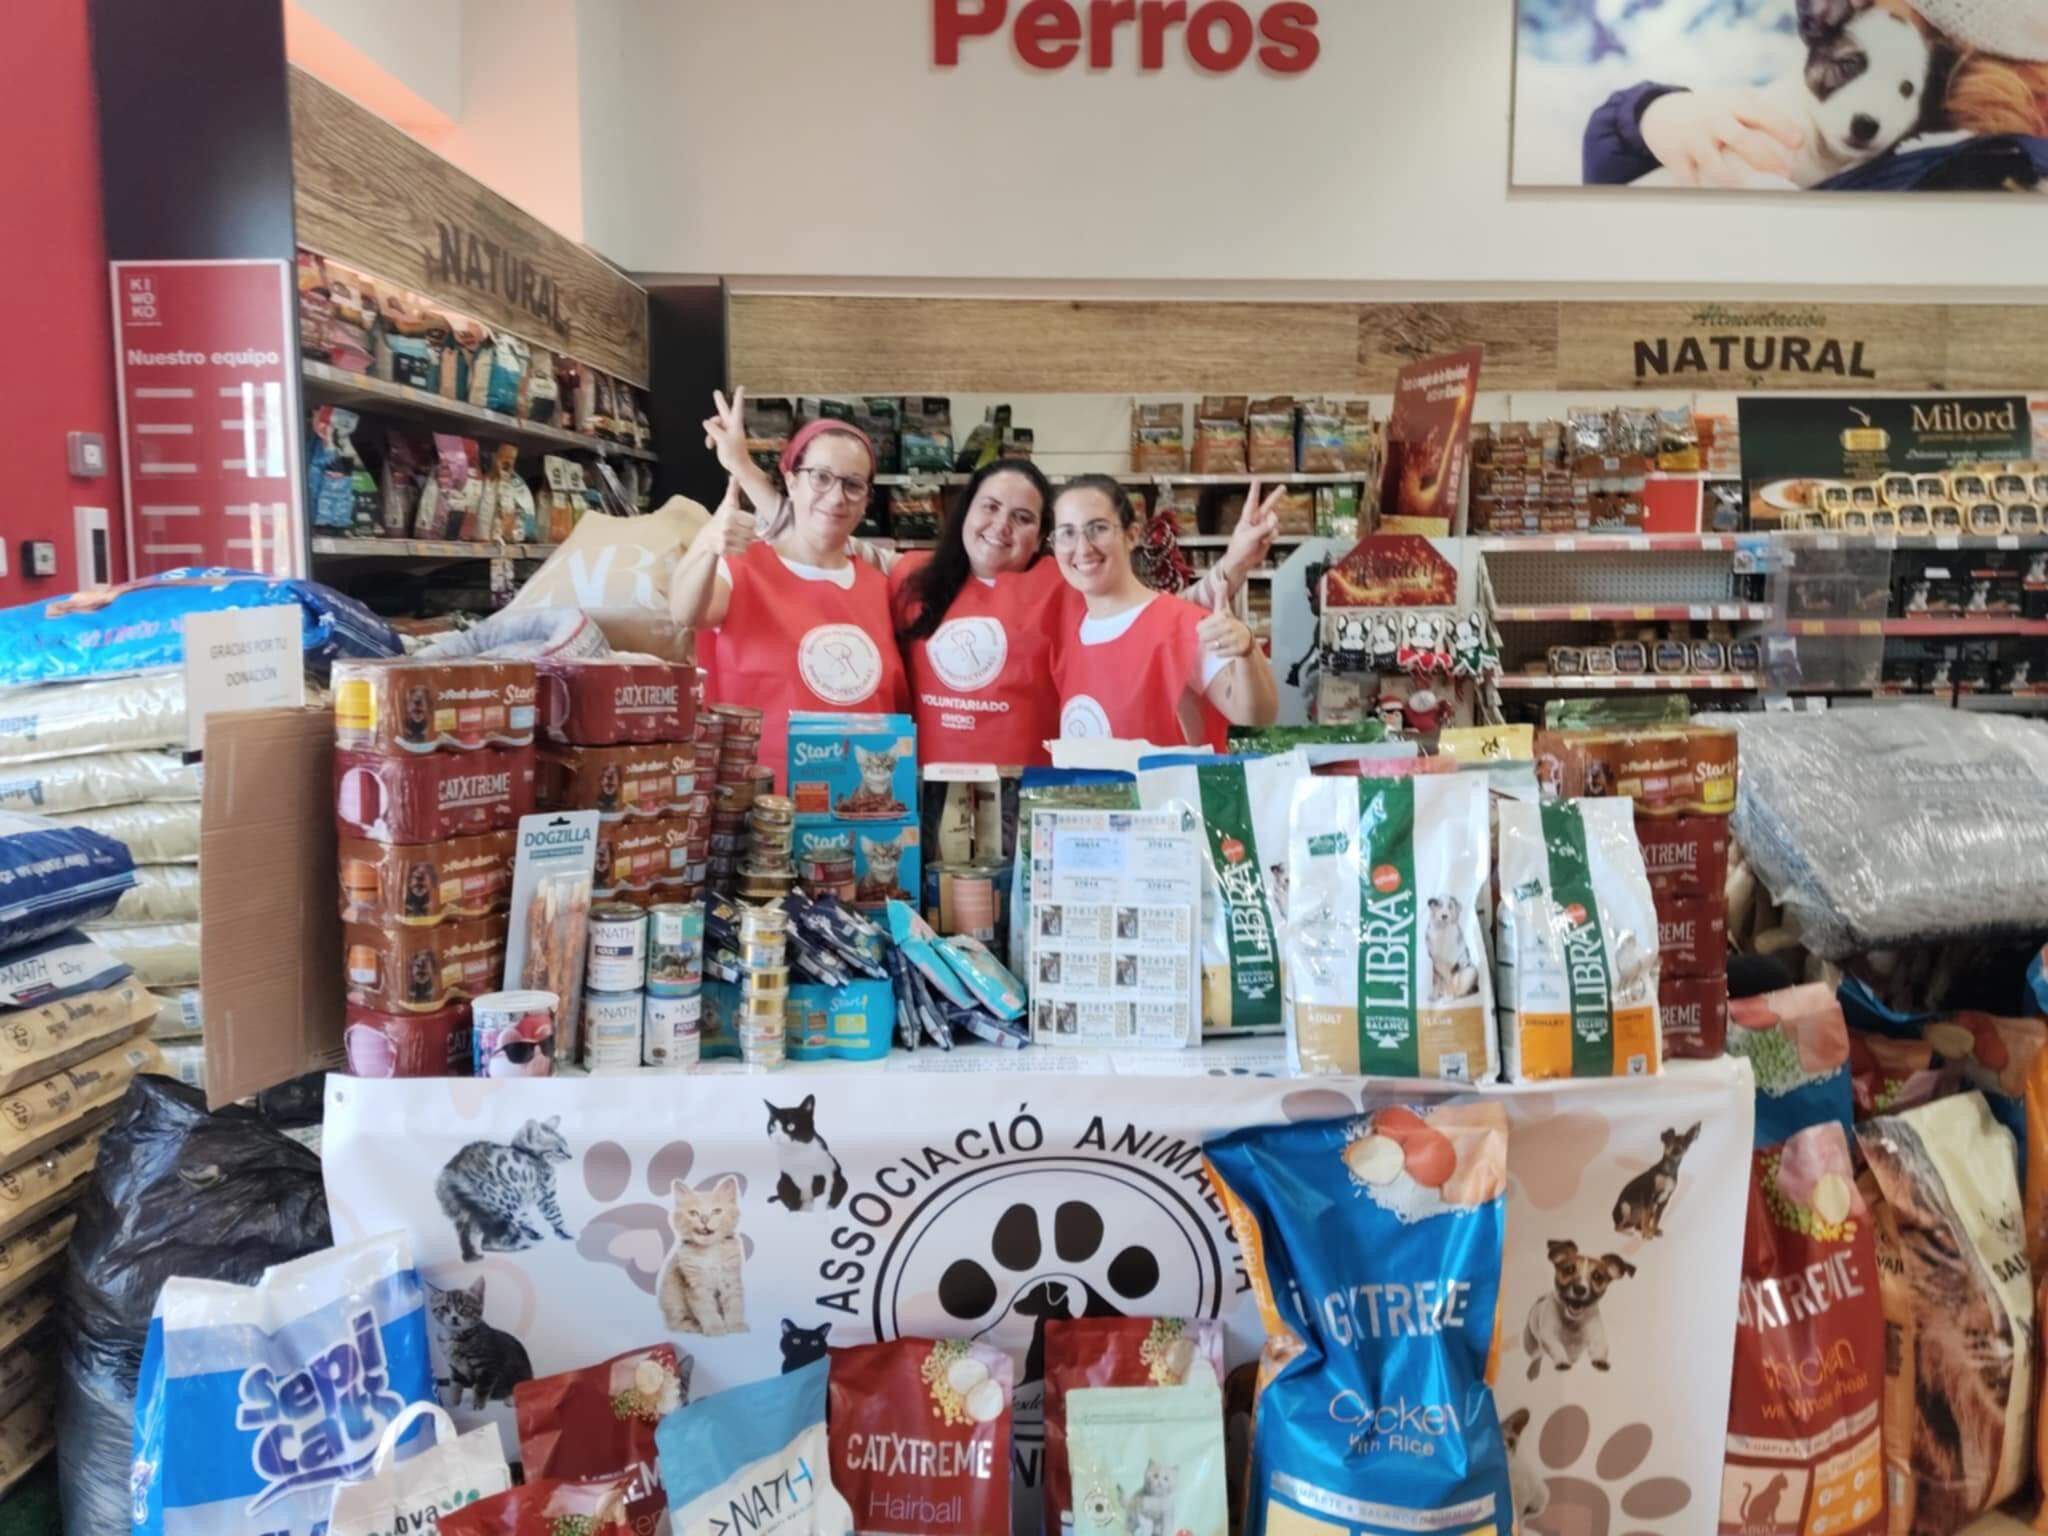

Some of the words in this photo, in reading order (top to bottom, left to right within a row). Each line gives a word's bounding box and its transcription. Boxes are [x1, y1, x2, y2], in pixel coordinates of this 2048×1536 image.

[933, 0, 1320, 73] Perros
[127, 349, 206, 365] Nuestro
[211, 349, 280, 368] equipo
[1633, 336, 1876, 379] NATURAL
[1910, 402, 2016, 432] Milord
[615, 685, 678, 705] CATXTREME
[921, 694, 1009, 713] VOLUNTARIADO
[438, 771, 511, 801] CATXTREME
[524, 826, 592, 848] DOGZILLA
[1365, 889, 1414, 1011] LIBRA
[1561, 920, 1608, 1014] LIBRA
[816, 1103, 1044, 1315] ASSOCIACIÓ
[239, 1309, 388, 1428] Sepi
[847, 1432, 994, 1480] CATXTREME
[1389, 1433, 1435, 1457] Rice
[868, 1491, 962, 1524] Hairball
